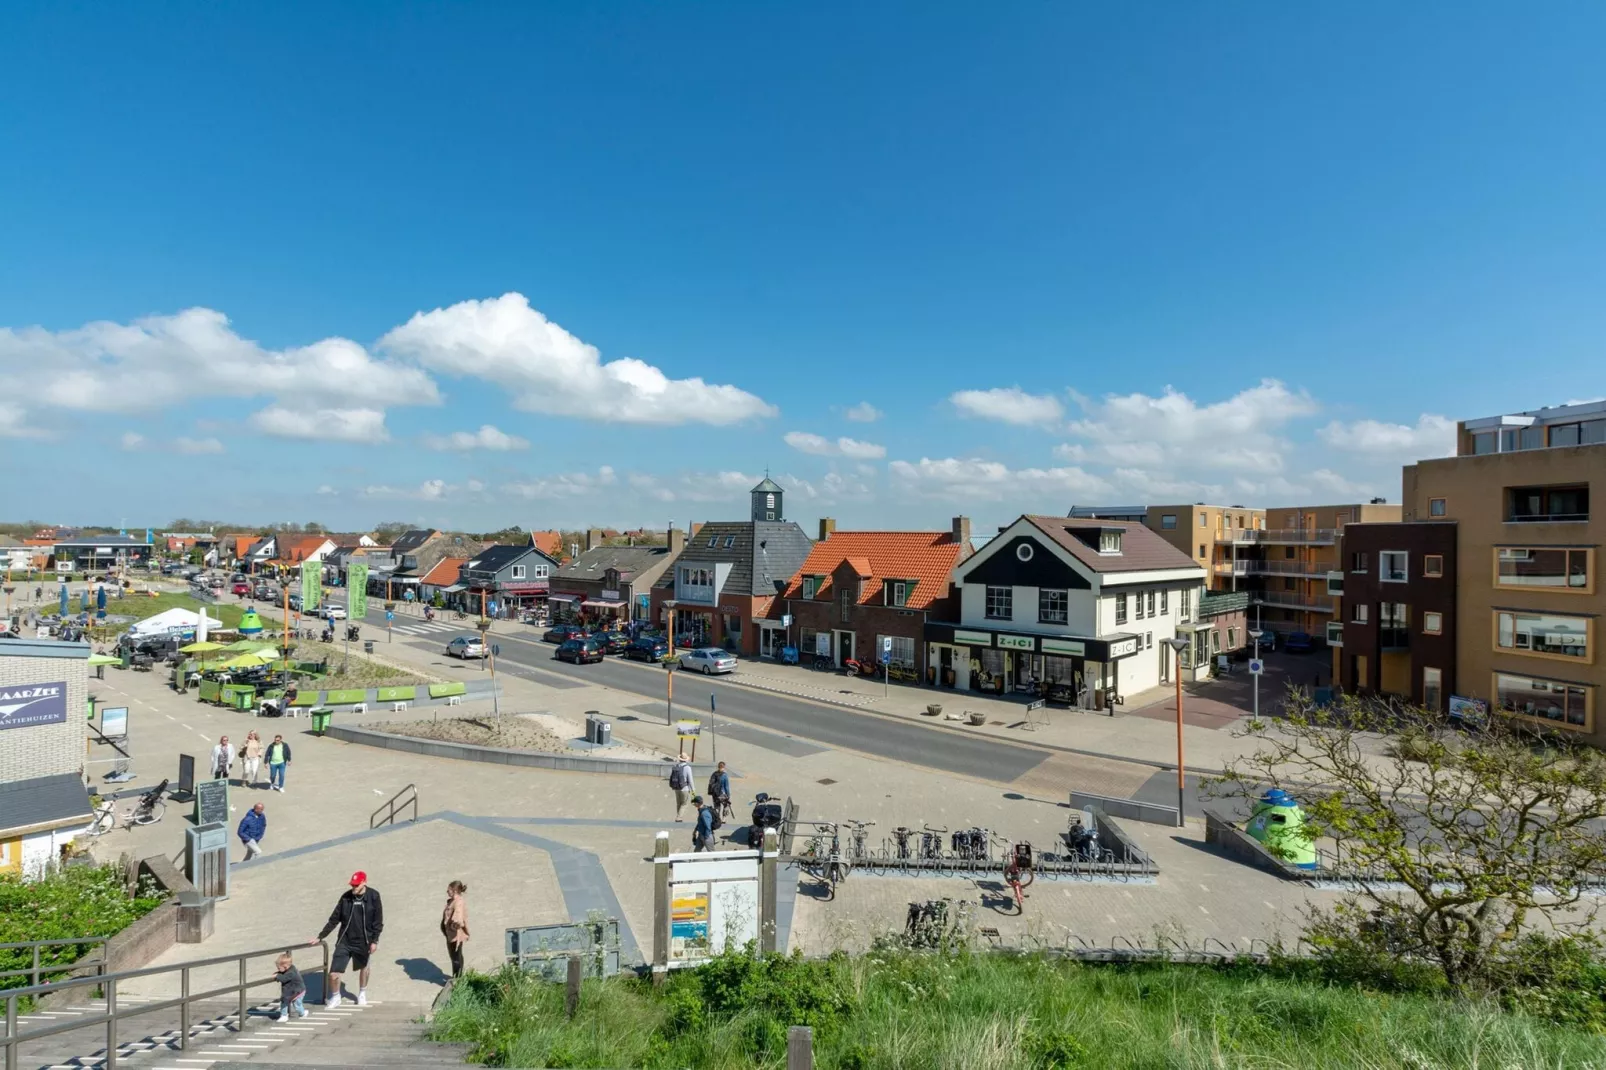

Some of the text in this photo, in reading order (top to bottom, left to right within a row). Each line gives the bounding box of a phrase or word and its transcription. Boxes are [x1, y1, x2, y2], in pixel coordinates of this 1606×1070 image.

[169, 625, 198, 633] Heineke
[1000, 637, 1032, 648] Z-ICI
[0, 687, 60, 700] AARZEE
